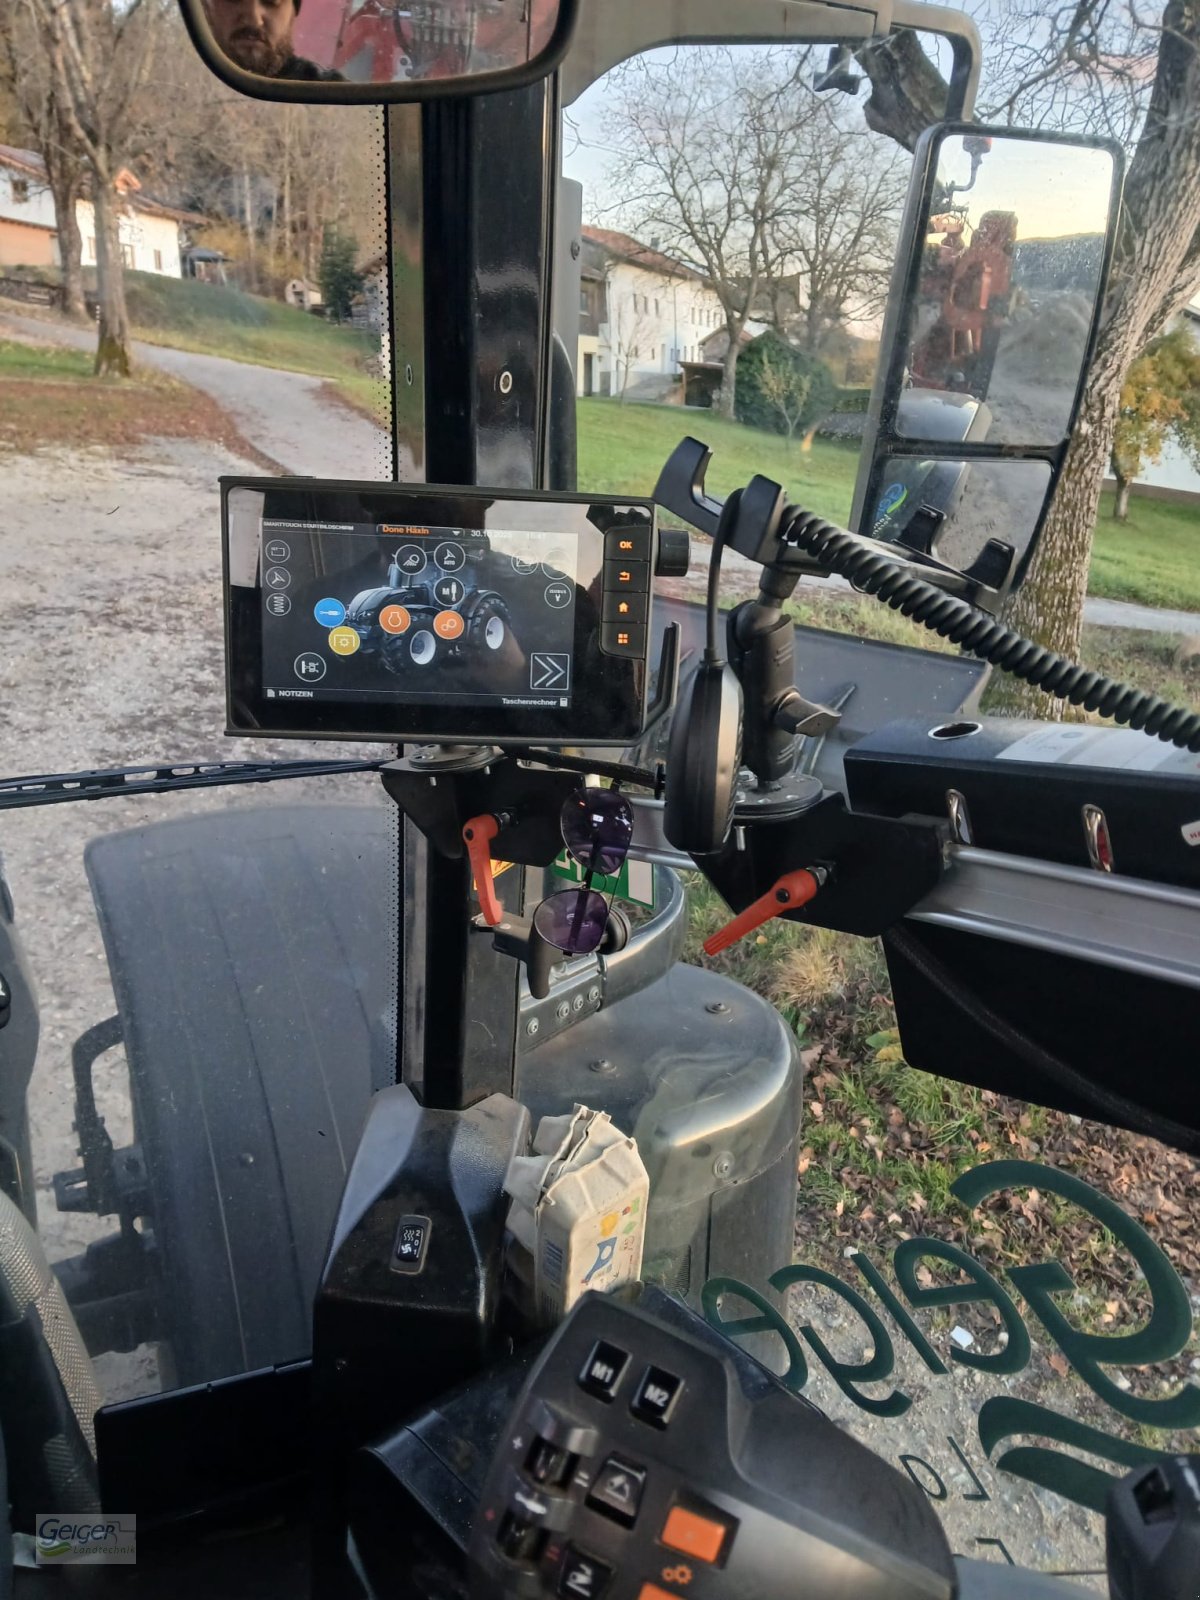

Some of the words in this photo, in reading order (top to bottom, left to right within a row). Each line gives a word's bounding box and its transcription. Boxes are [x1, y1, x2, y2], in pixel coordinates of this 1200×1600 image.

[619, 540, 633, 549] OK
[278, 690, 314, 698] NOTIZEN
[501, 697, 558, 706] Taschenrechner
[415, 1229, 421, 1237] 2
[591, 1361, 614, 1383] M1
[644, 1383, 669, 1407] M2
